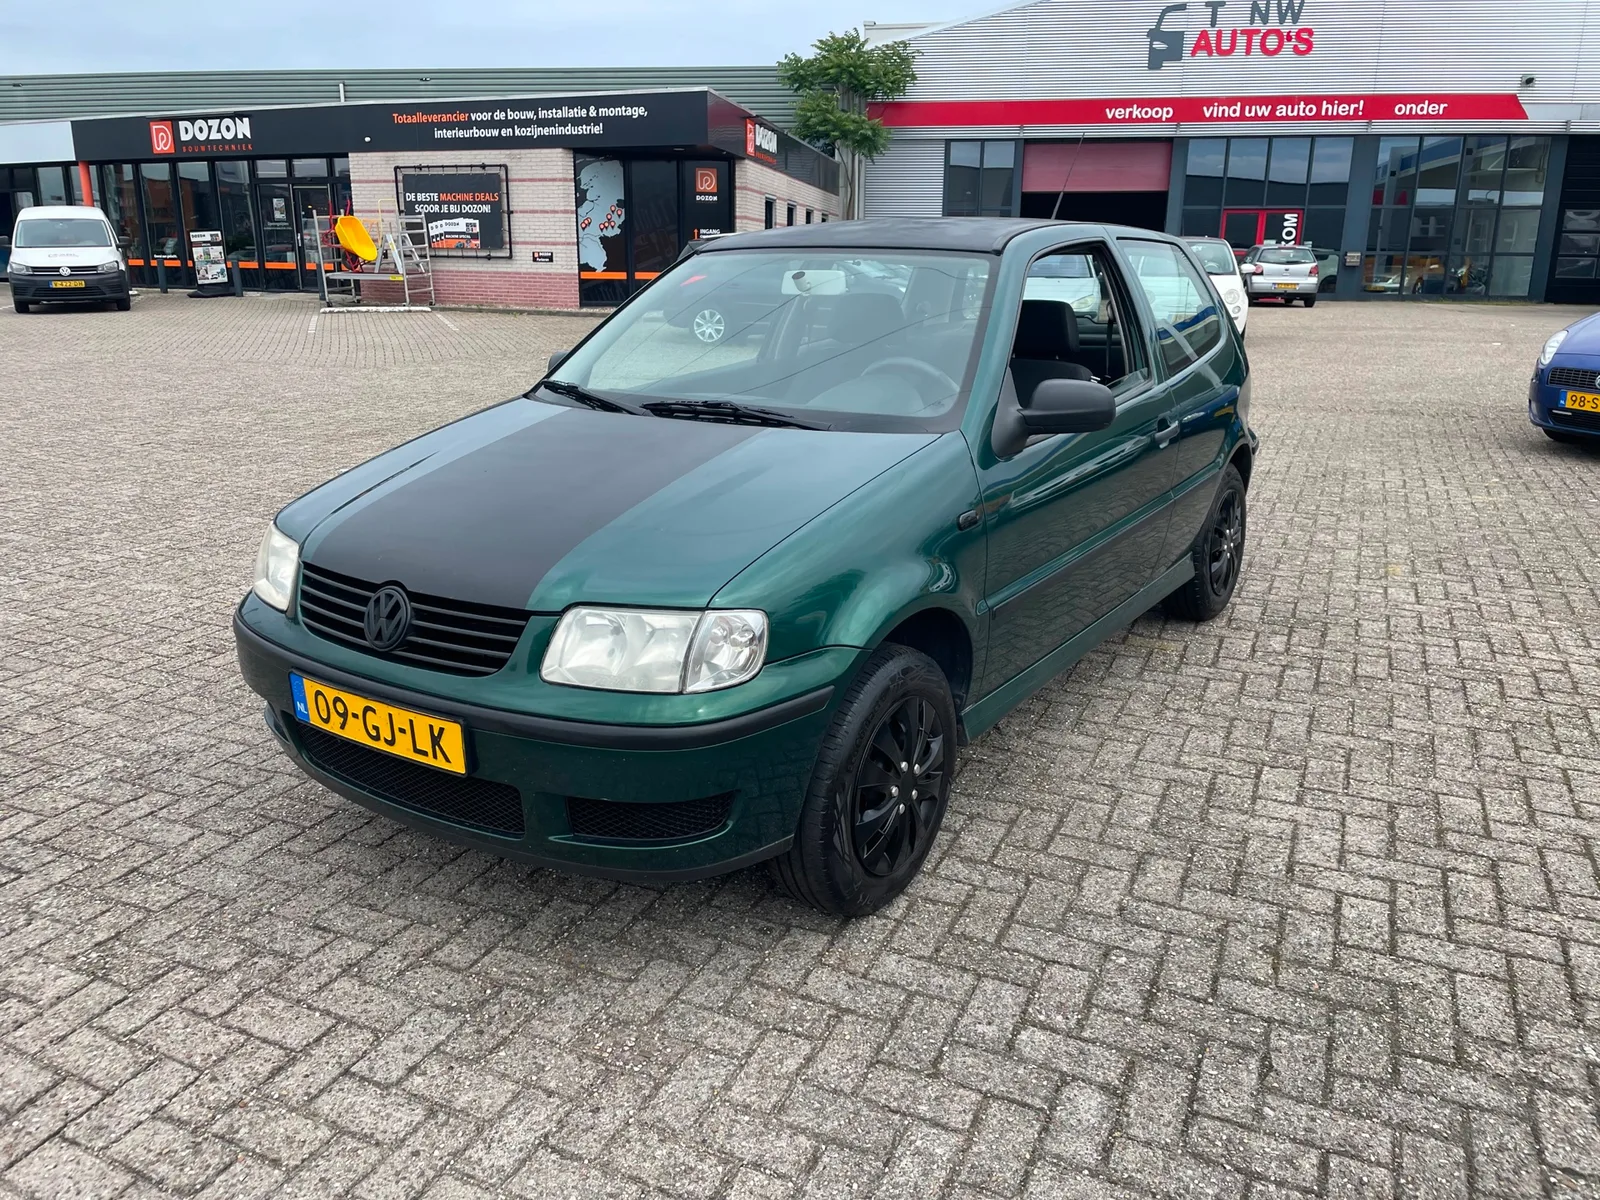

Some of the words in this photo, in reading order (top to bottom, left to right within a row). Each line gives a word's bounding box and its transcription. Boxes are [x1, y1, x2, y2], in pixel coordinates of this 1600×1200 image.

[1205, 0, 1226, 28] T
[1249, 0, 1305, 25] NW
[392, 110, 469, 124] Totaalleverancier
[470, 112, 492, 121] voor
[493, 109, 506, 120] de
[507, 108, 537, 120] bouw,
[538, 105, 587, 119] installatie
[588, 105, 597, 117] &
[598, 105, 648, 119] montage,
[1105, 103, 1174, 121] verkoop
[1203, 102, 1241, 118] vind
[1244, 104, 1272, 117] uw
[1275, 101, 1317, 117] auto
[1321, 99, 1364, 116] hier!
[1394, 99, 1448, 116] onder
[178, 117, 252, 142] DOZON
[434, 126, 499, 139] interieurbouw
[500, 128, 513, 137] en
[514, 122, 603, 139] kozijnenindustrie!
[182, 143, 253, 153] BOUWTECHNIEK
[405, 192, 416, 202] DE
[416, 192, 439, 202] BESTE
[439, 192, 474, 201] MACHINE
[474, 192, 499, 201] DEALS
[414, 204, 440, 213] SCOOR
[440, 204, 449, 213] JE
[449, 204, 461, 213] BIJ
[461, 204, 491, 213] DOZON!
[296, 701, 308, 715] NL
[314, 689, 452, 764] 09-GJ-LK
